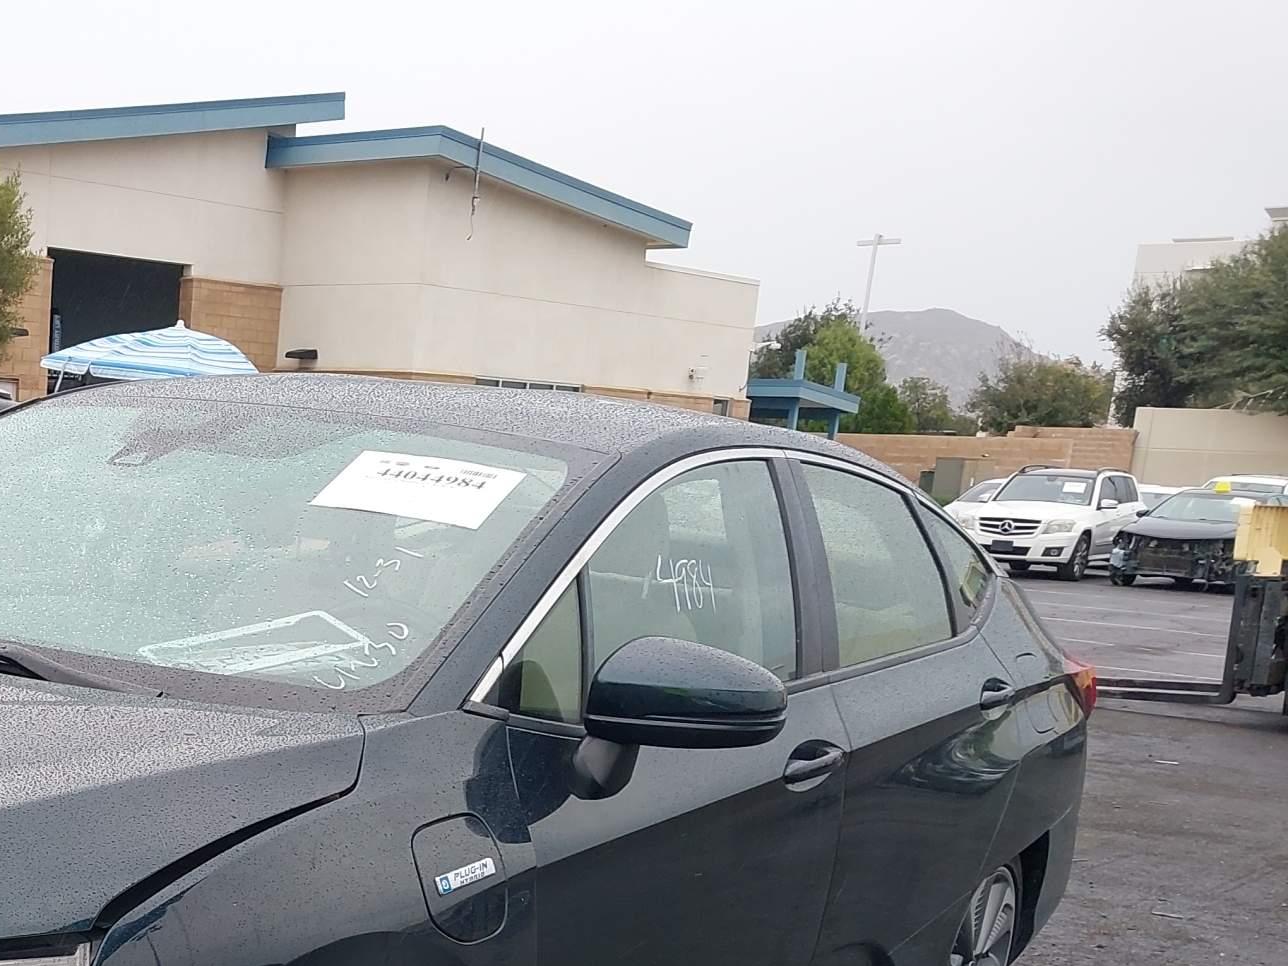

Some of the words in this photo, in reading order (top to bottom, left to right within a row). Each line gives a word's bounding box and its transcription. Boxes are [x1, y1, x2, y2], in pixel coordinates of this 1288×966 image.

[377, 468, 486, 489] 44044984
[656, 554, 716, 613] 4984
[453, 861, 488, 881] PLUG-IN
